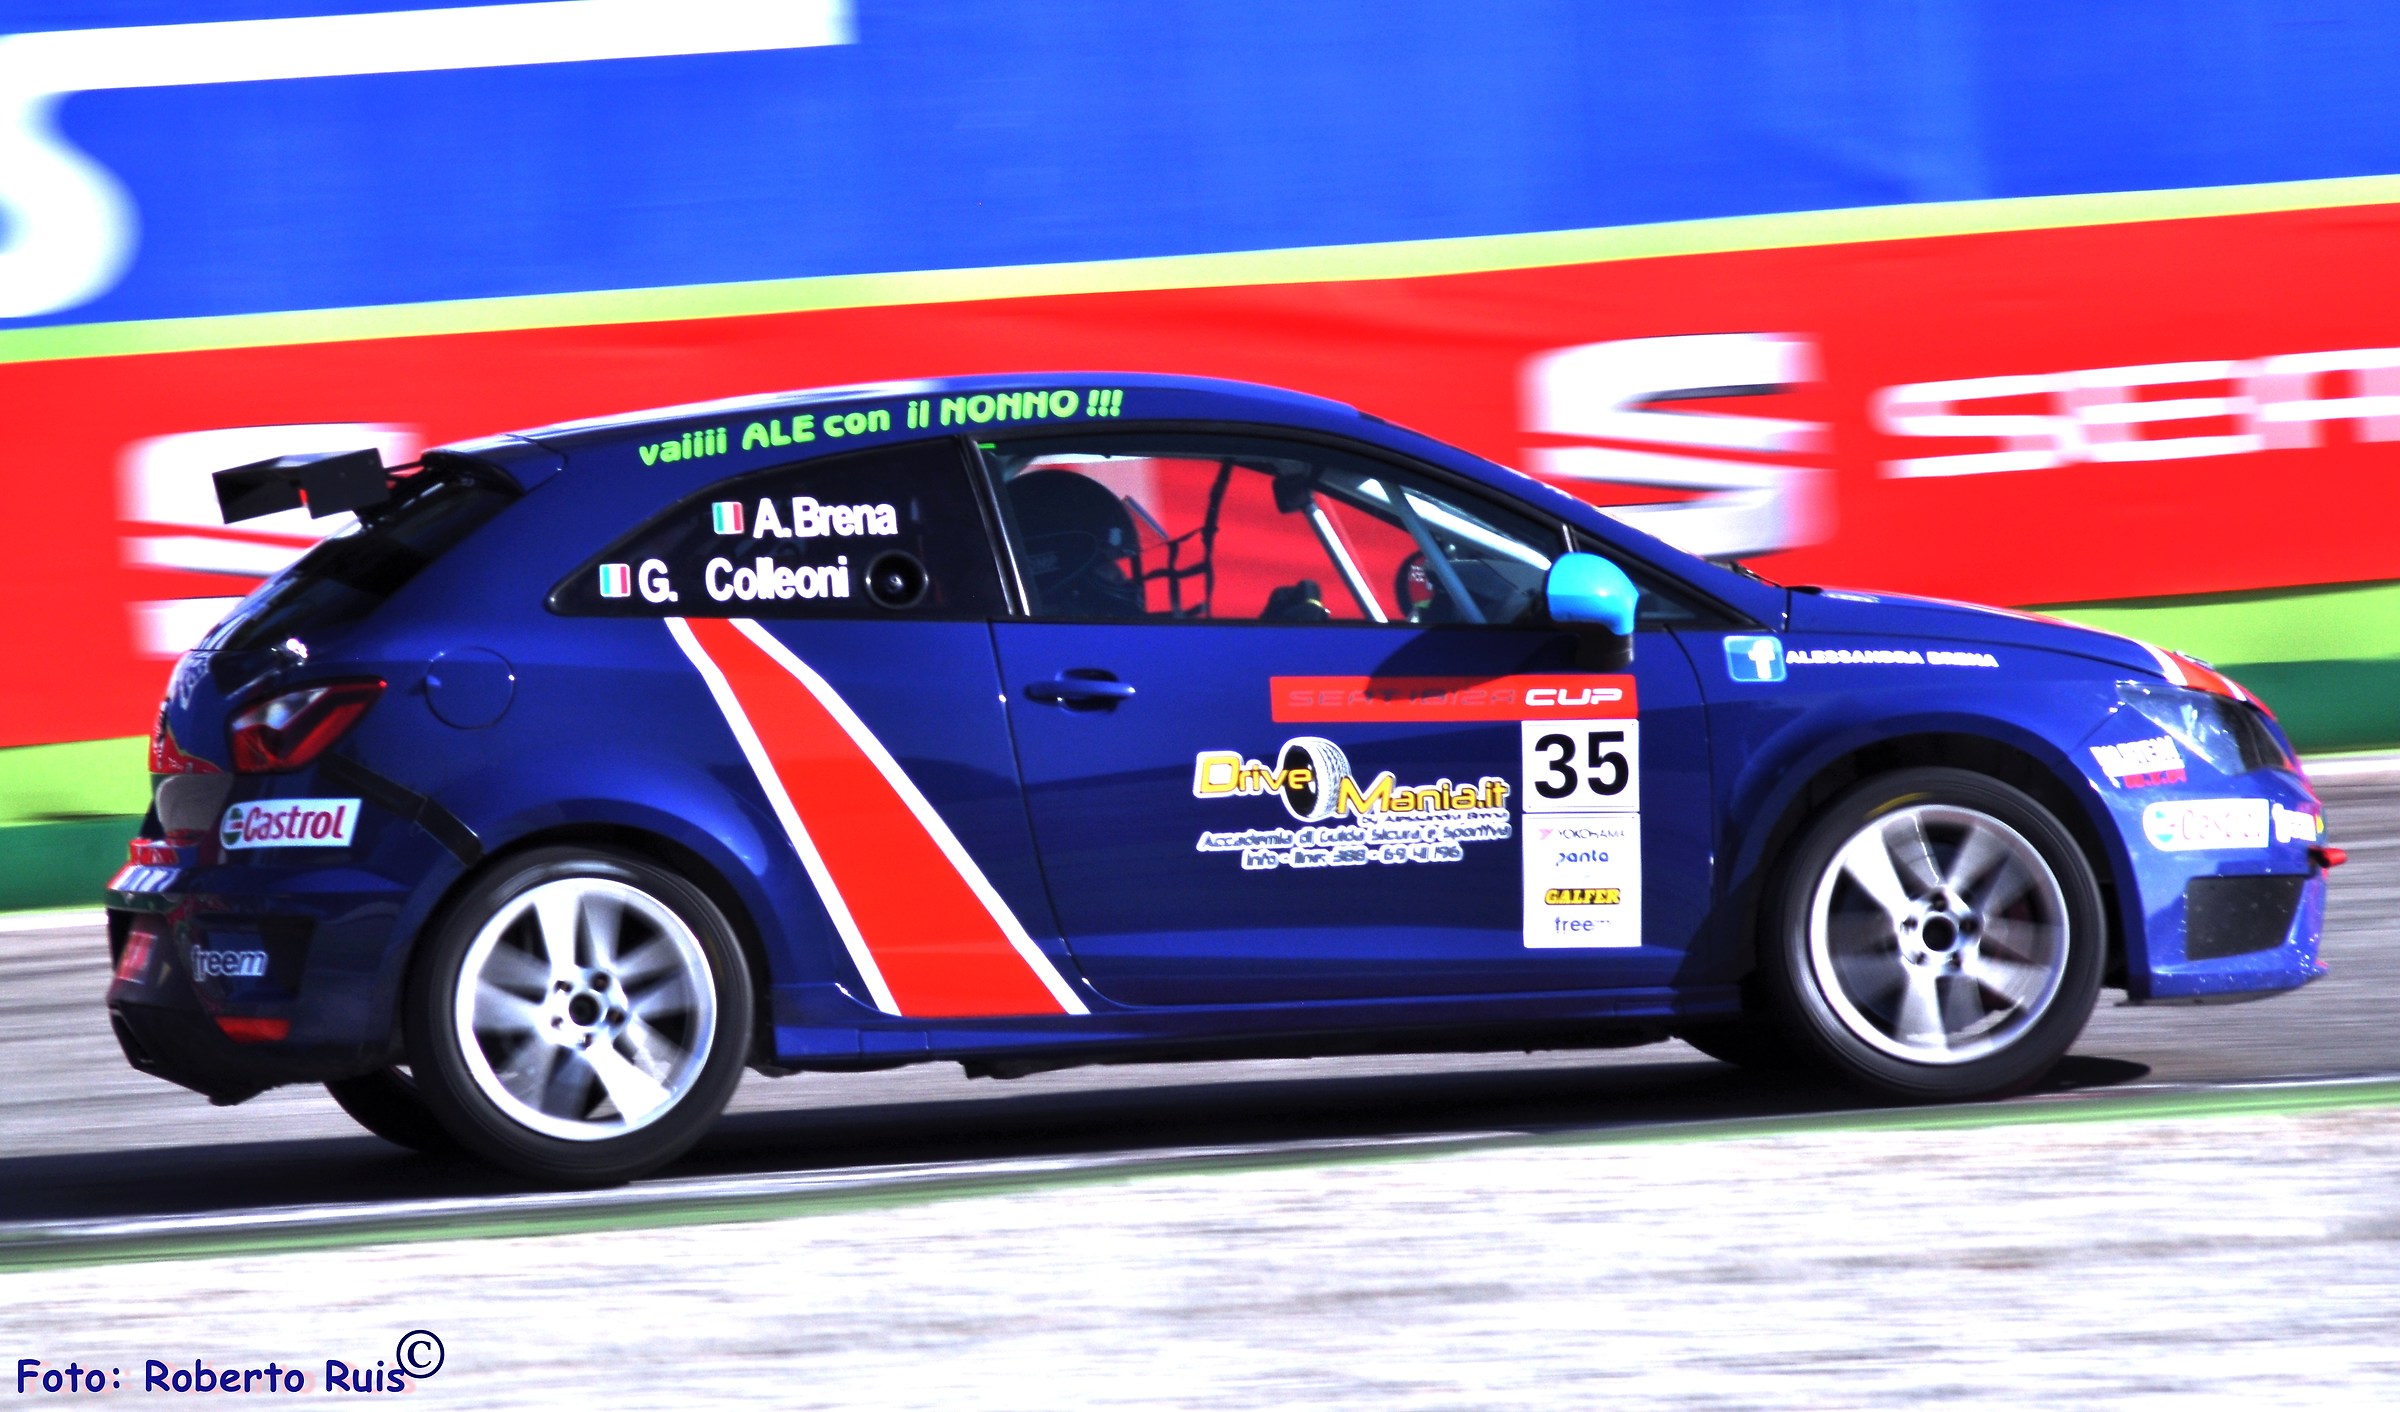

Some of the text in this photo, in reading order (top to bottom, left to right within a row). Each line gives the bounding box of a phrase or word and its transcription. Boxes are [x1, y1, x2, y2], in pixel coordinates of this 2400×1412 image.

[639, 388, 1124, 466] vaiiii ALE con il NONNO !!!
[752, 496, 898, 539] A.Brena
[638, 555, 850, 602] G. Colleoni
[1786, 650, 1925, 665] ALESSANDRA
[1288, 689, 1400, 708] SEAT
[1525, 688, 1623, 706] CUP
[1200, 755, 1313, 793] Drive
[1534, 731, 1630, 799] 35
[1336, 774, 1508, 815] Mania.it
[244, 806, 346, 842] Castrol
[1545, 889, 1620, 905] GALFER
[1554, 916, 1611, 934] free
